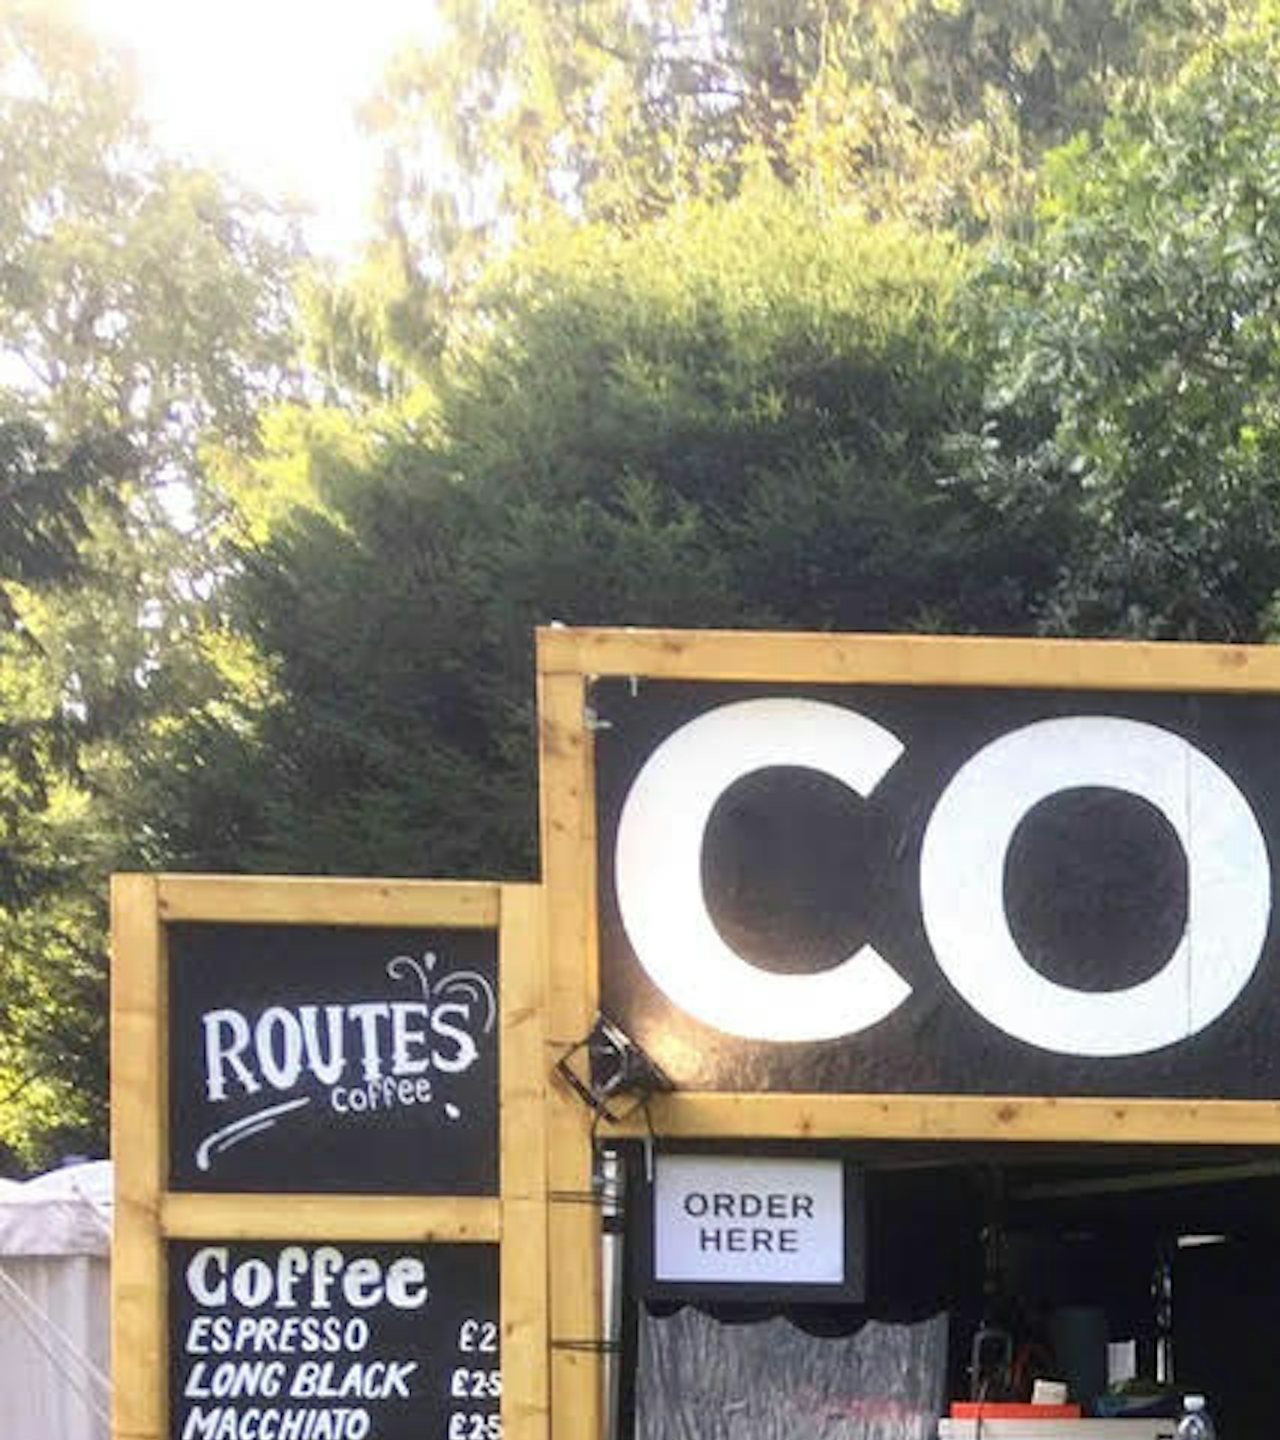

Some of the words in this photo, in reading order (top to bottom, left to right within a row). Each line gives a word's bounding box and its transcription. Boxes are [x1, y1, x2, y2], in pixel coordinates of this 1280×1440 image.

[202, 1001, 479, 1102] ROUTES
[331, 1075, 432, 1113] coffee
[684, 1193, 815, 1219] ORDER
[700, 1228, 799, 1252] HERE
[186, 1246, 428, 1310] Coffee
[186, 1315, 369, 1353] ESPRESSO
[459, 1318, 498, 1353] £2
[185, 1362, 286, 1399] LONG
[290, 1362, 417, 1399] BLACK
